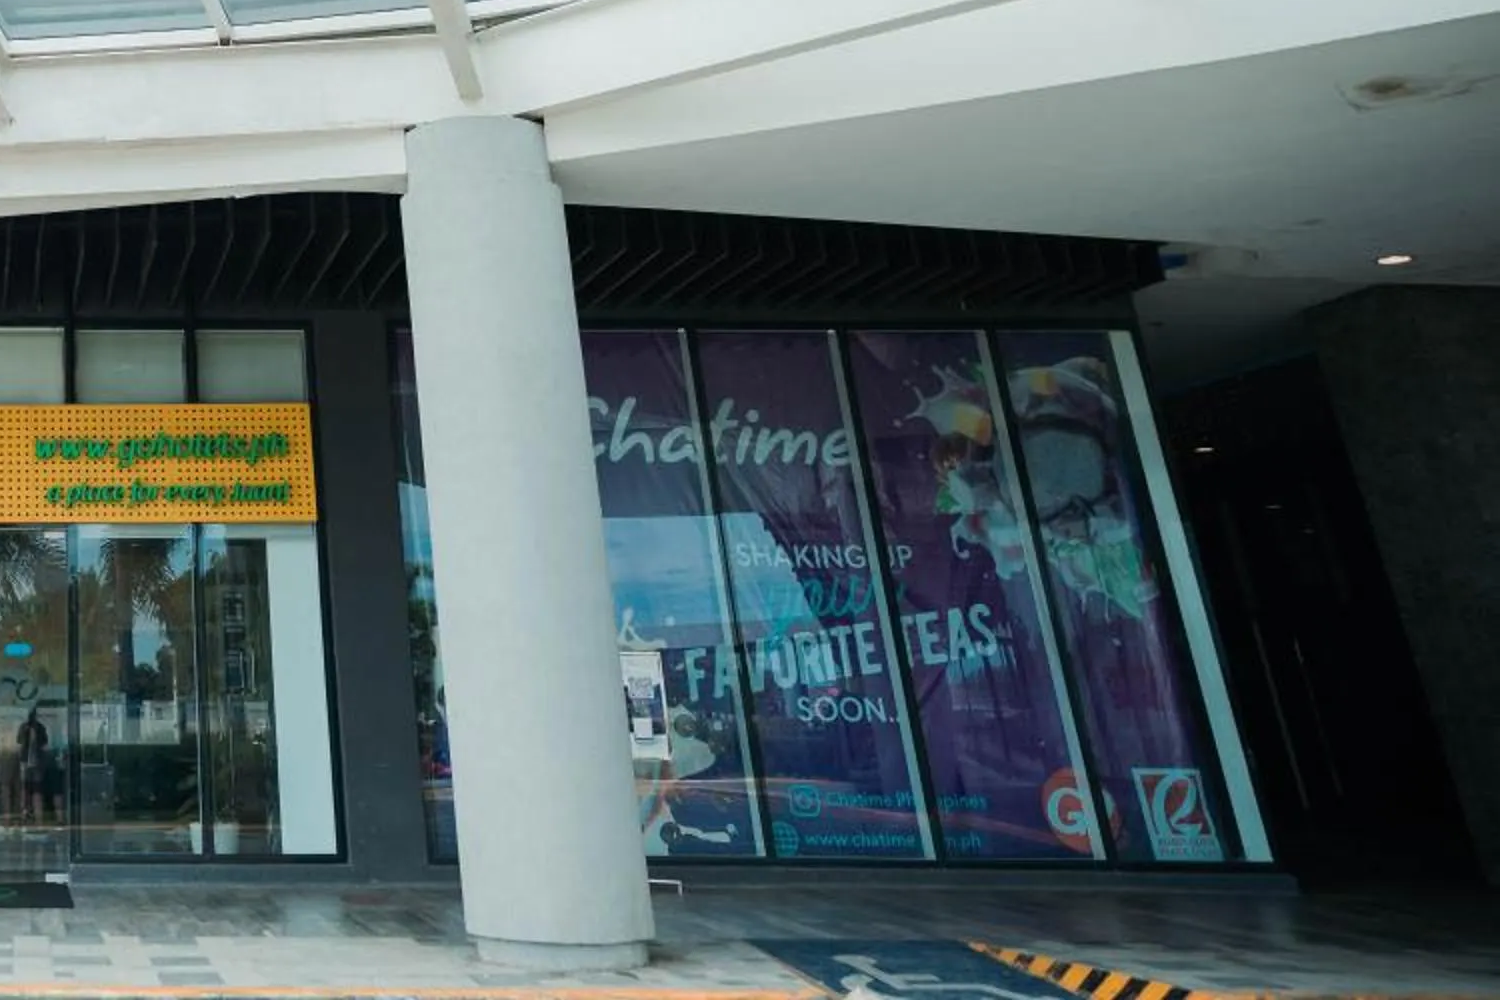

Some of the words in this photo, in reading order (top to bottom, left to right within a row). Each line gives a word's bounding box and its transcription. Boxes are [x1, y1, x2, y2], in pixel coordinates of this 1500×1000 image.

[35, 432, 289, 468] www.gohotels.ph
[735, 544, 867, 568] SHAKING
[684, 621, 883, 701] FAVORITE
[901, 603, 998, 667] TEAS
